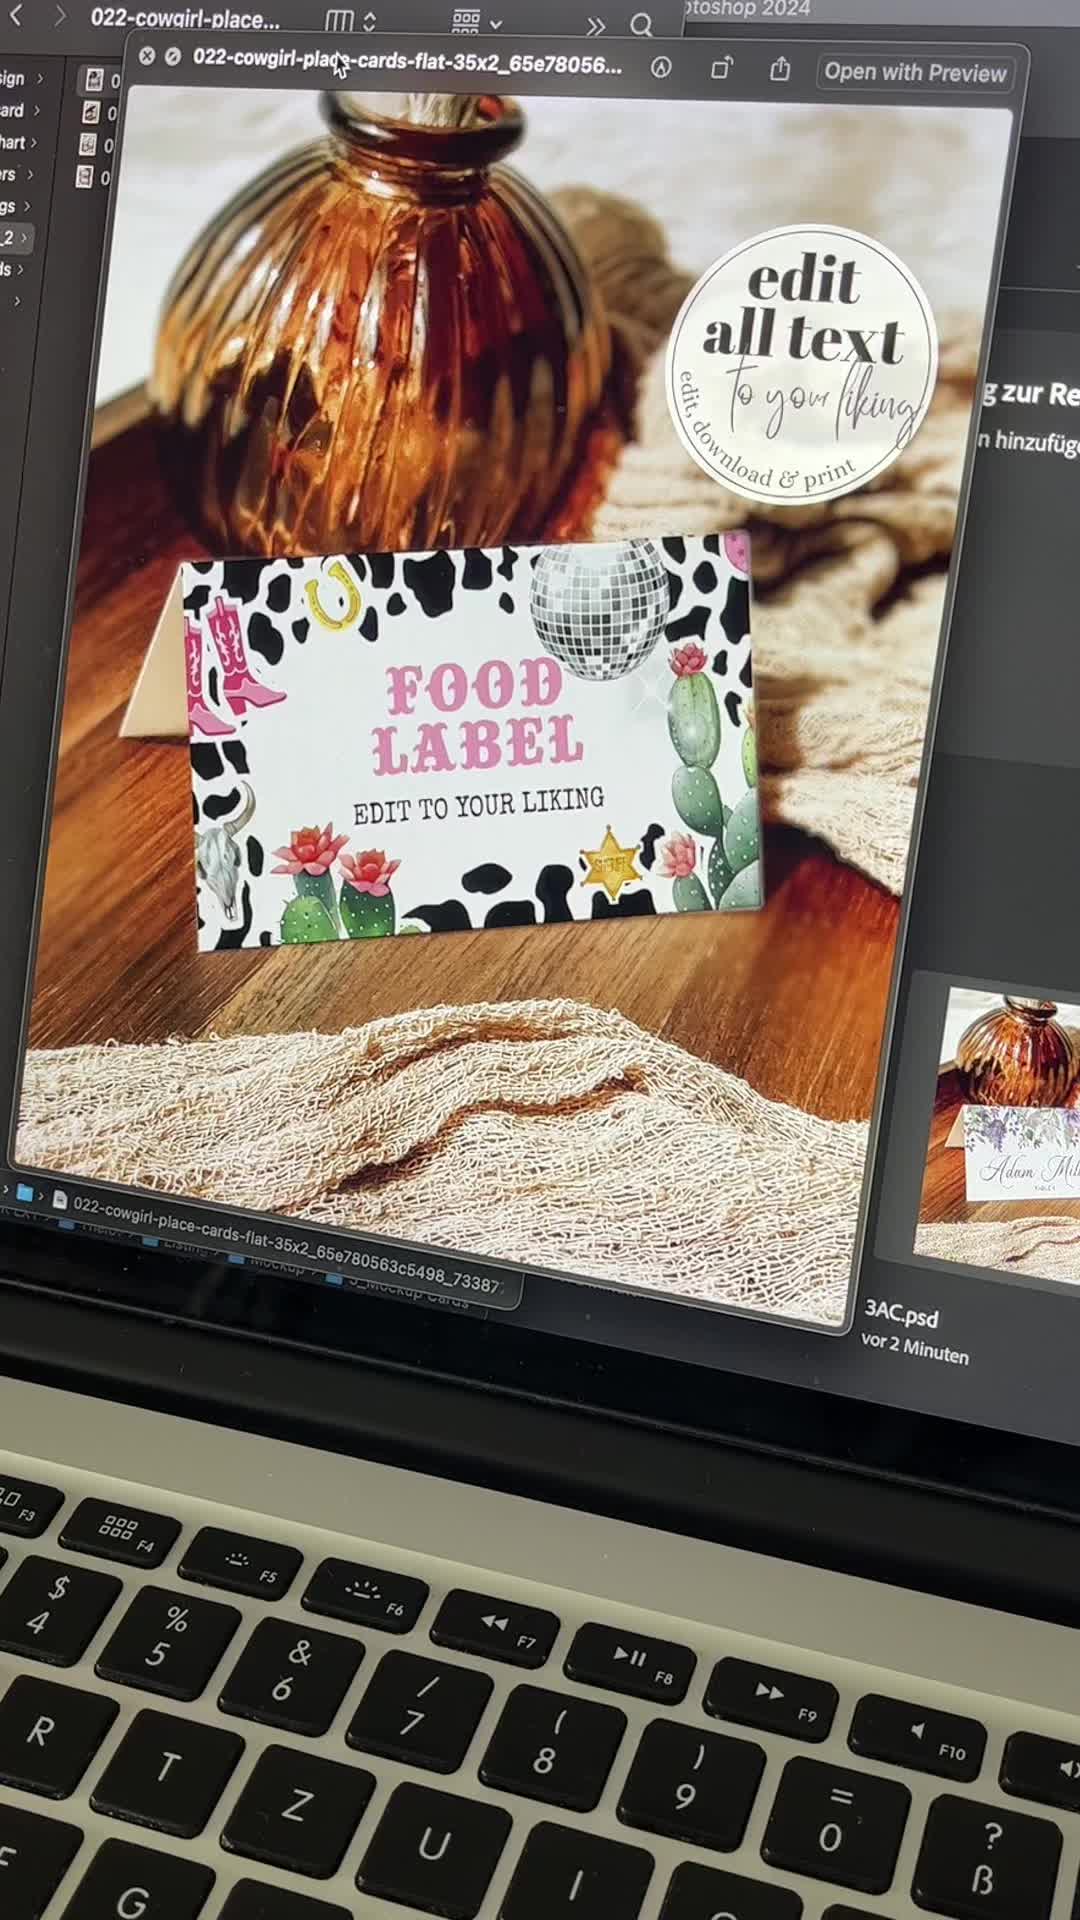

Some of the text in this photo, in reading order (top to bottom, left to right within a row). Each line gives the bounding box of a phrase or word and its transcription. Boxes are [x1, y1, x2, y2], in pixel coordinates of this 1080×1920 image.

[762, 0, 811, 17] 2024
[825, 61, 1007, 84] Open with Preview
[747, 252, 862, 305] edit
[703, 306, 905, 366] all text
[766, 386, 830, 440] your
[835, 359, 922, 451] liking
[1002, 383, 1044, 405] zur
[1050, 382, 1080, 407] Re
[680, 370, 857, 492] edit, download & print
[385, 657, 563, 716] FOOD
[371, 714, 585, 777] LABEL
[353, 785, 605, 826] EDIT TO YOUR LIKING
[979, 1153, 1033, 1189] Adam
[865, 1299, 939, 1329] 3AC.psd
[861, 1332, 970, 1366] vor 2 Minuten
[18, 1507, 36, 1522] F3
[136, 1538, 155, 1554] F4
[47, 1575, 71, 1601] $
[259, 1569, 278, 1584] F5
[26, 1611, 50, 1635] 4
[166, 1605, 188, 1633] %
[386, 1602, 404, 1617] F6
[145, 1641, 171, 1667] 5
[287, 1639, 312, 1667] &
[516, 1634, 537, 1650] F7
[271, 1674, 295, 1701] 6
[654, 1670, 674, 1686] F8
[400, 1709, 425, 1736] 7
[797, 1707, 818, 1723] F9
[26, 1715, 55, 1747] R
[157, 1751, 183, 1782] T
[533, 1747, 556, 1774] 8
[939, 1743, 966, 1762] F10
[281, 1788, 315, 1822] Z
[675, 1783, 697, 1810] 9
[418, 1826, 452, 1861] U
[819, 1822, 843, 1853] 0
[984, 1821, 1003, 1850] ?
[971, 1864, 994, 1895] ß
[116, 1886, 150, 1920] G
